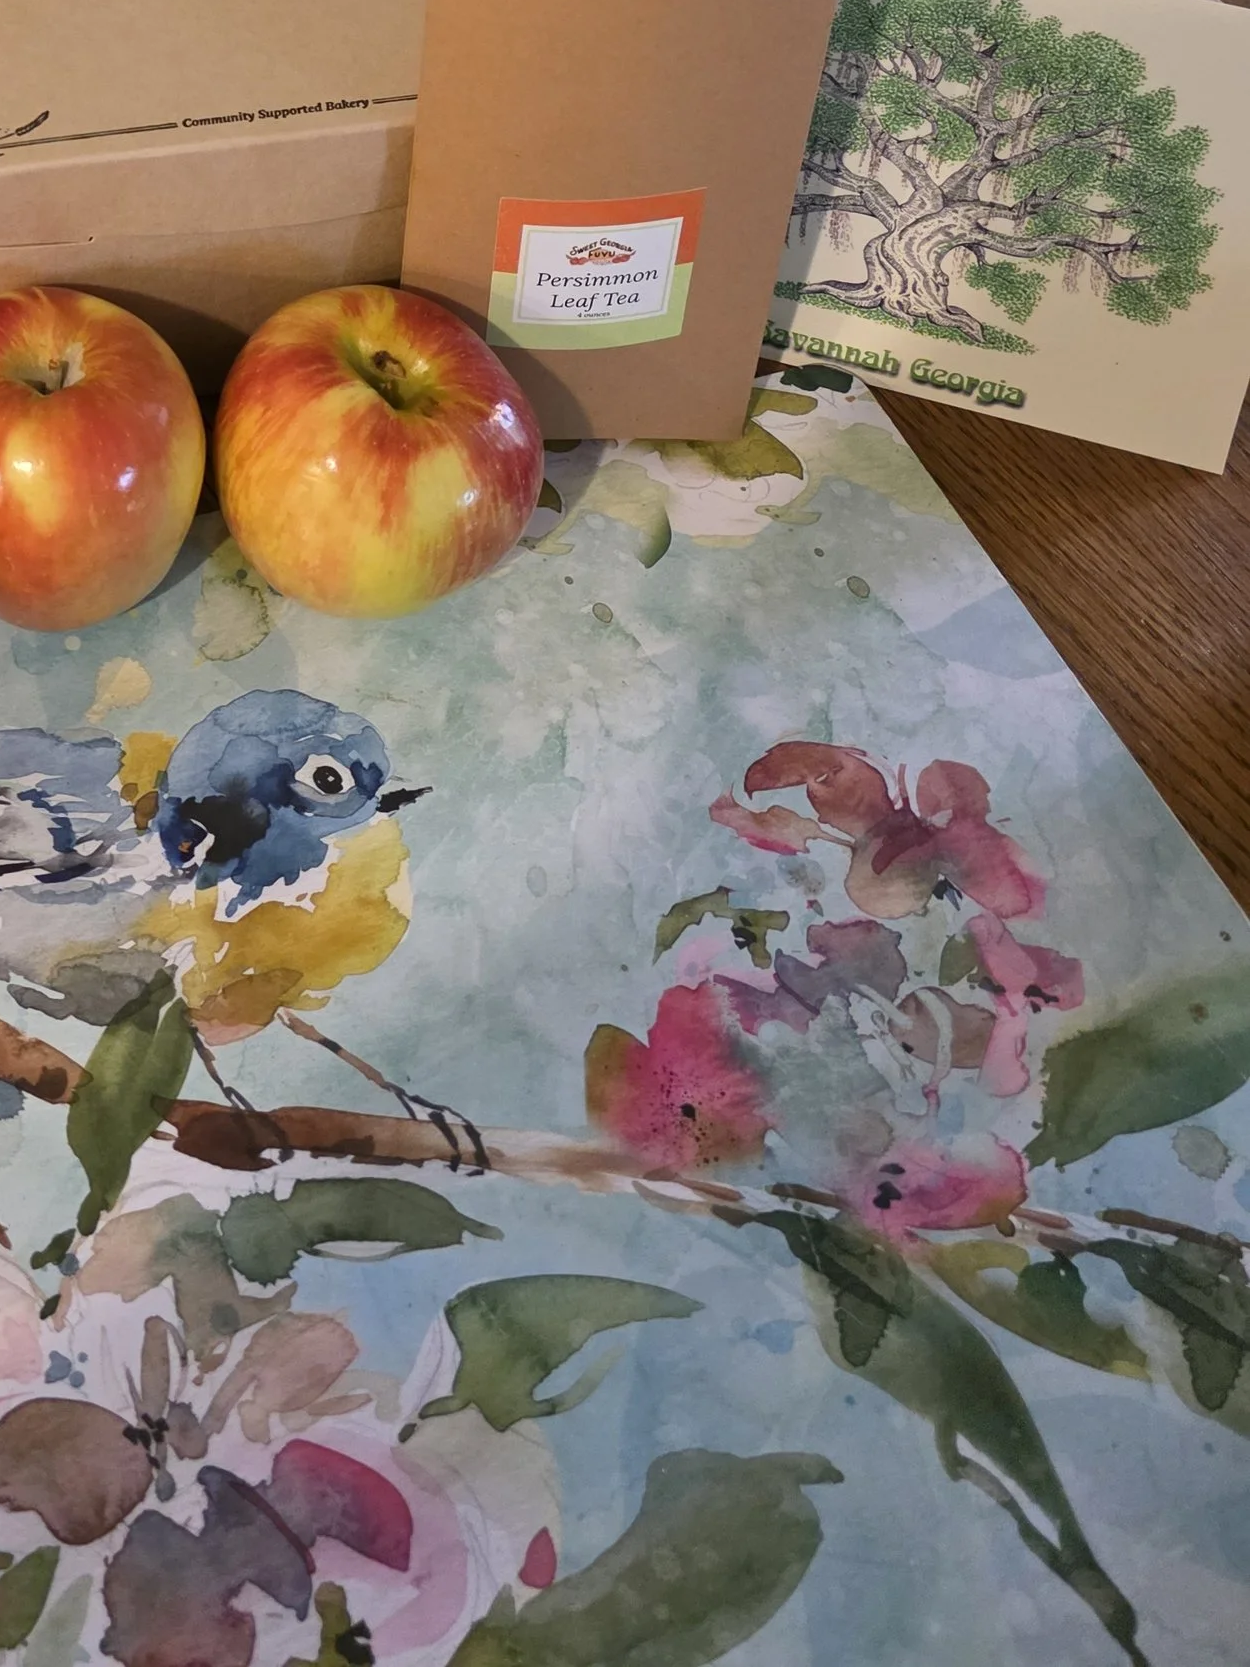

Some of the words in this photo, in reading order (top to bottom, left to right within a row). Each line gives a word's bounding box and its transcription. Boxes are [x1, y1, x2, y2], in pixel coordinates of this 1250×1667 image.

[182, 111, 255, 128] Community
[258, 102, 323, 120] Supported
[325, 98, 370, 111] Bakery
[536, 269, 659, 287] Persimmon
[551, 292, 600, 313] Leaf
[603, 291, 640, 307] Tea
[909, 358, 1025, 407] Georgia
